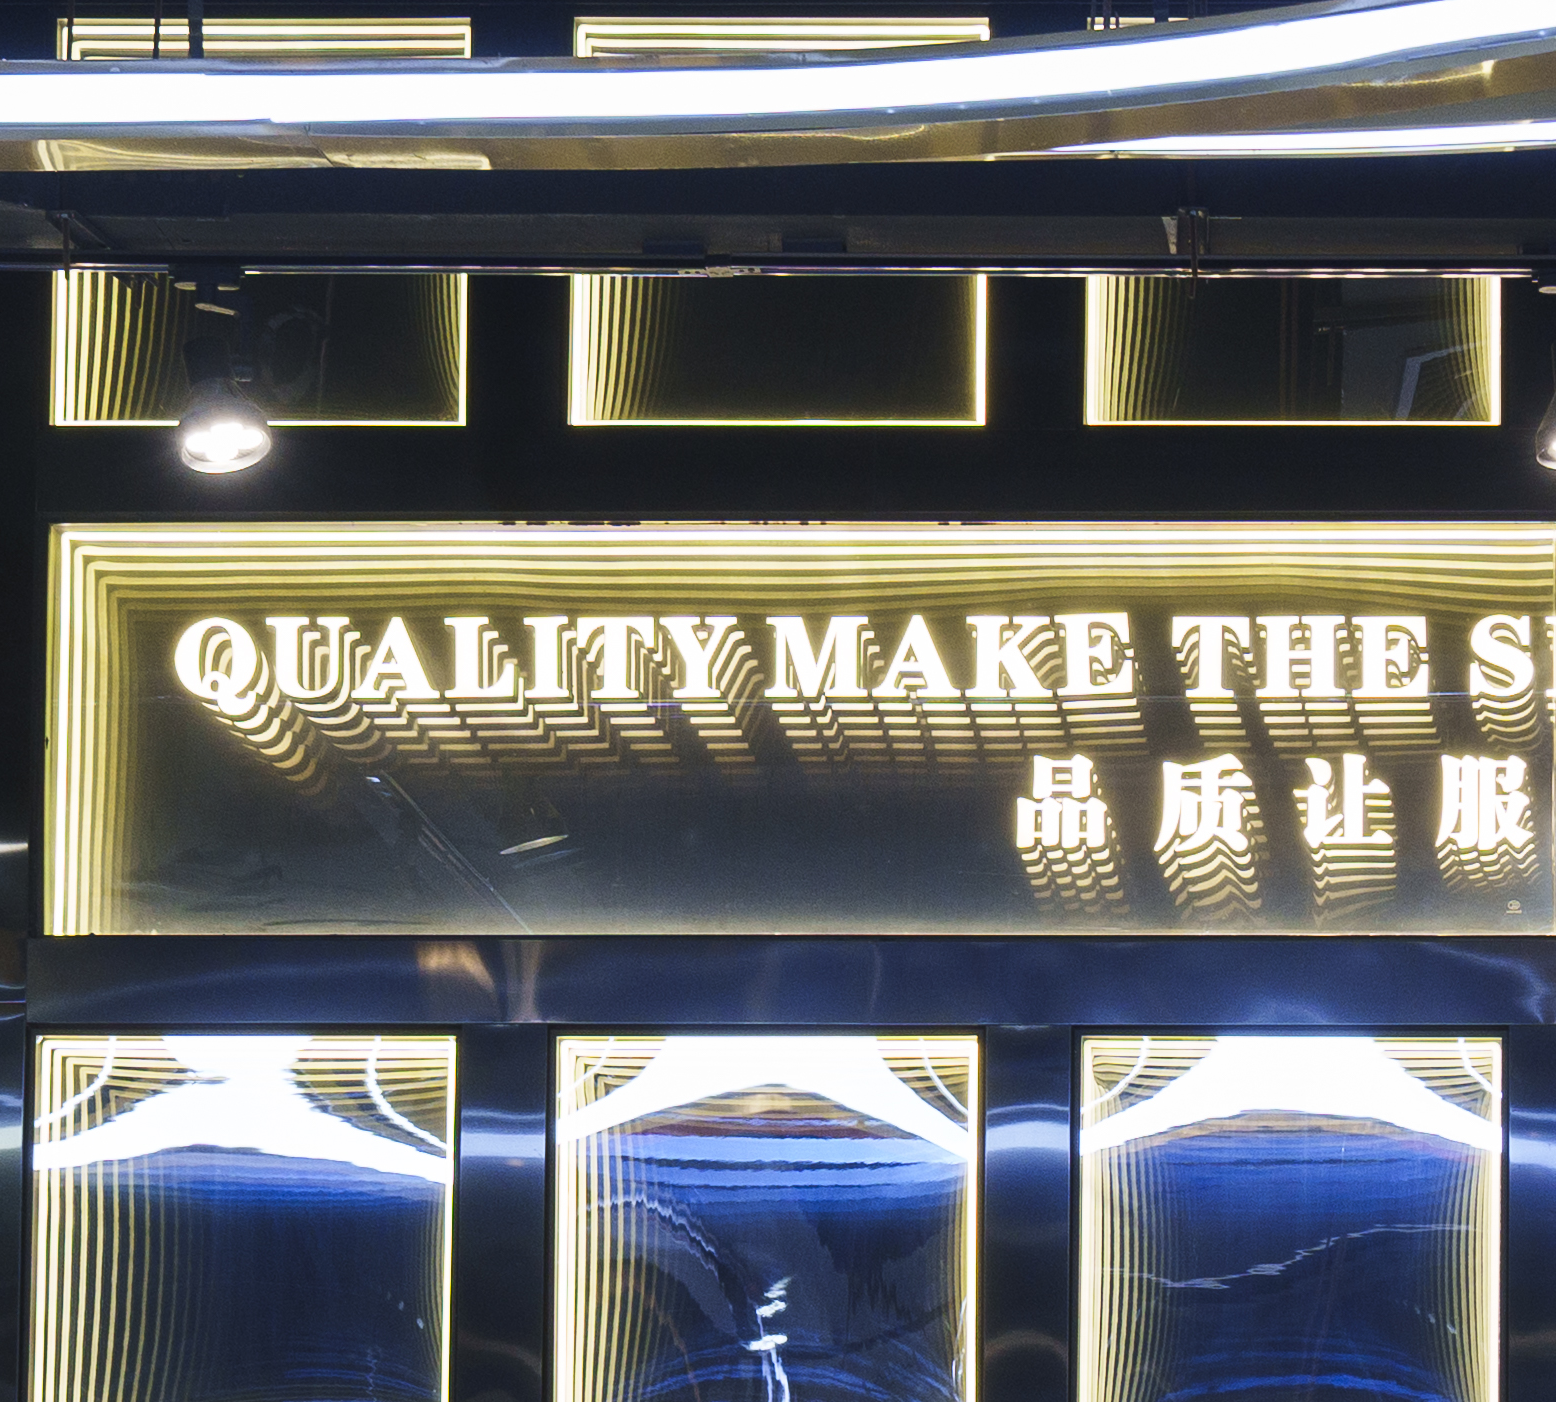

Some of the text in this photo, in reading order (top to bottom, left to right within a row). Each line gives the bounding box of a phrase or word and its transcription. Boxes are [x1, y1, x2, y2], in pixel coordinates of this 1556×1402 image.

[175, 615, 738, 710] QUALITY
[766, 612, 1135, 700] MAKE
[1169, 614, 1429, 698] THE
